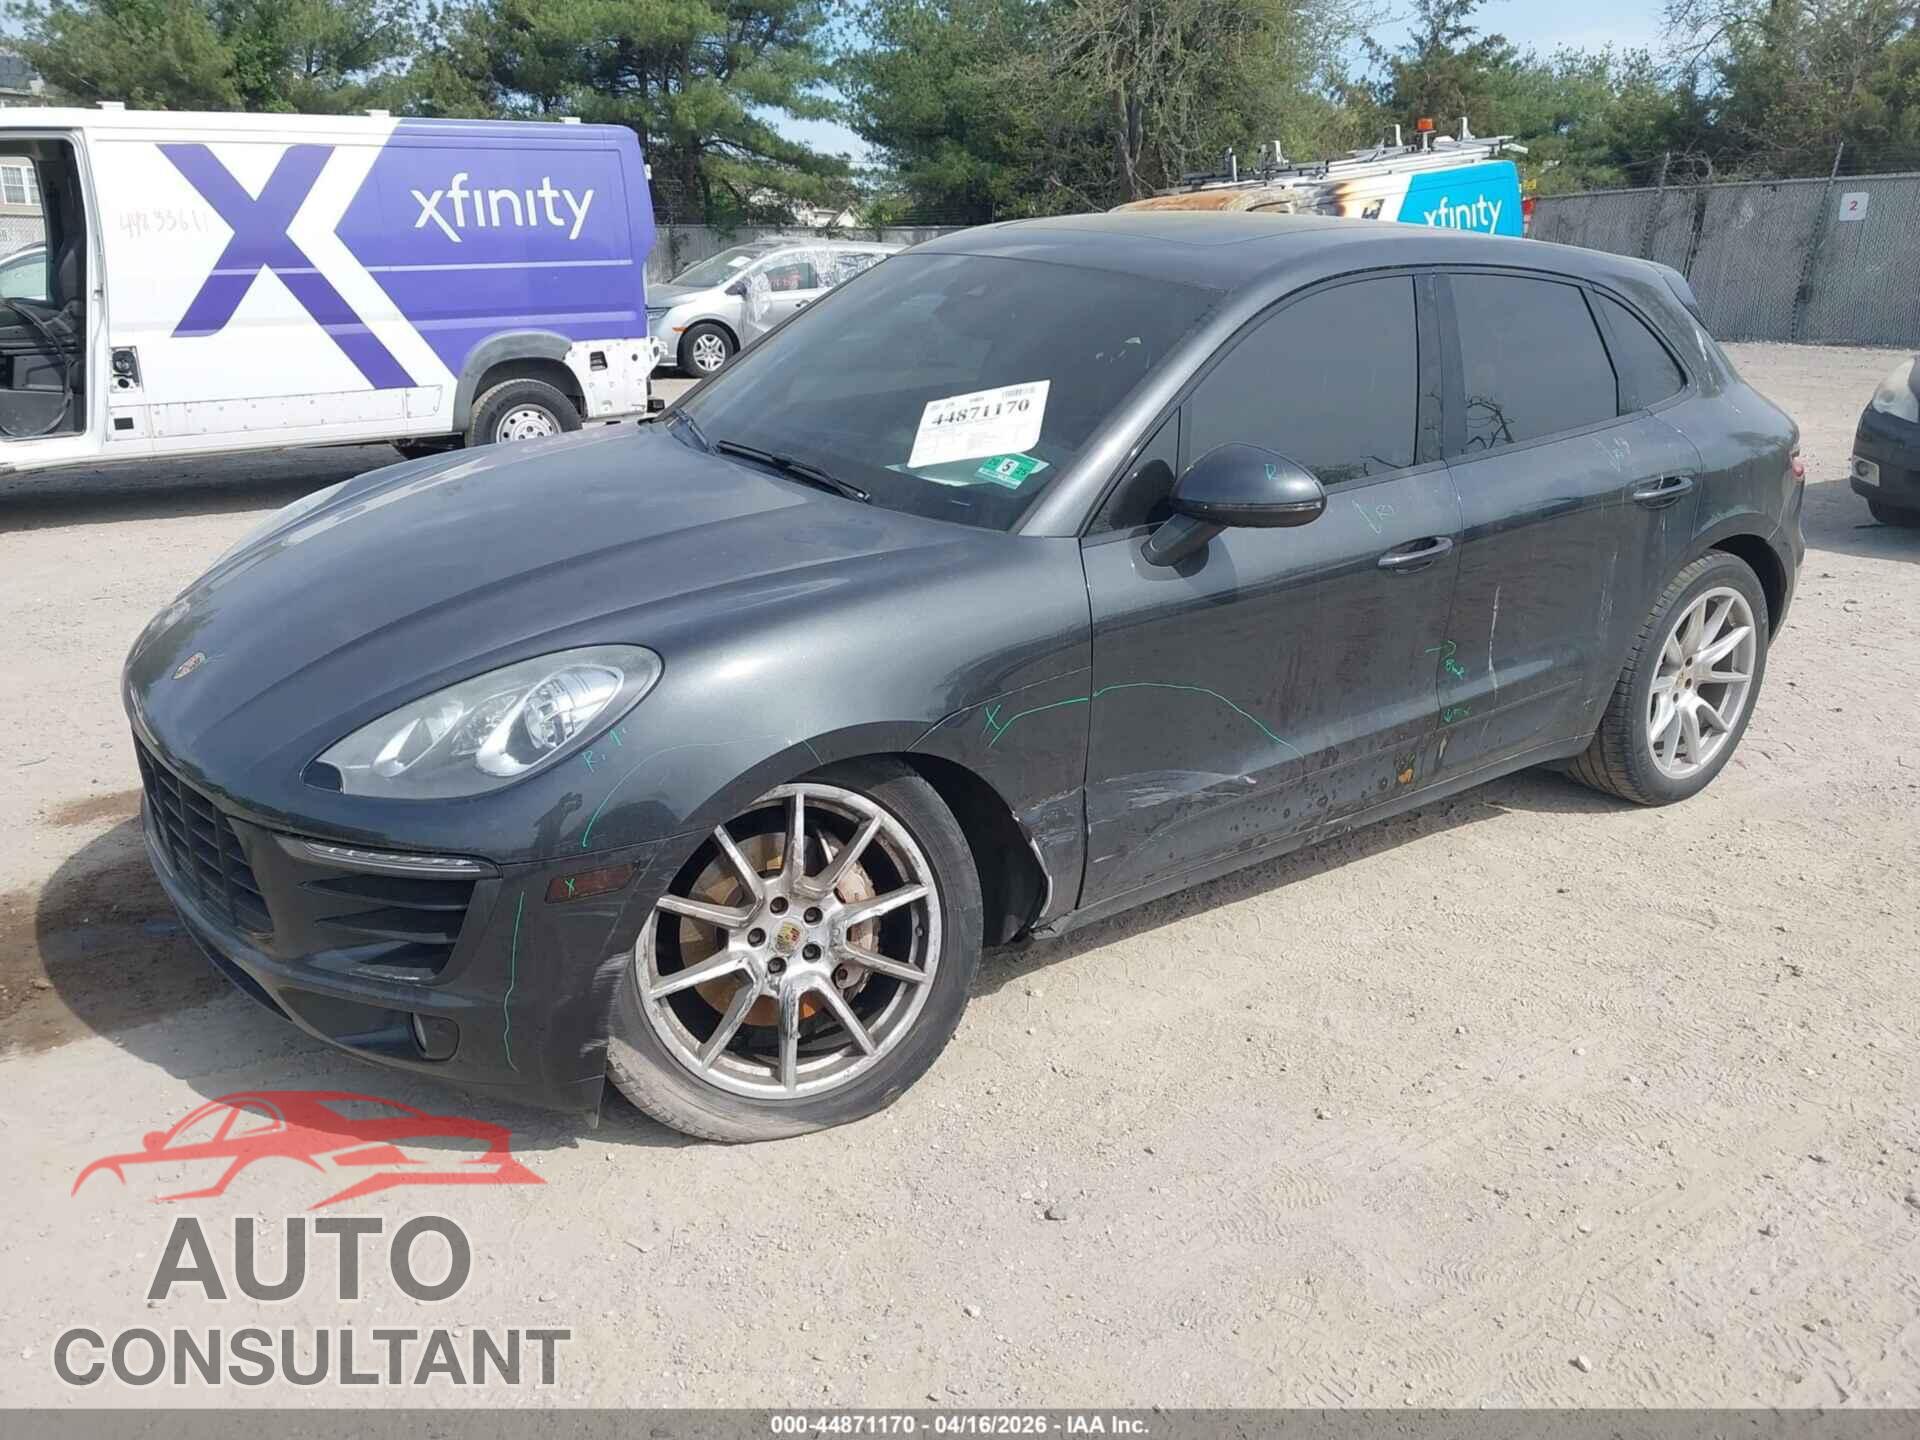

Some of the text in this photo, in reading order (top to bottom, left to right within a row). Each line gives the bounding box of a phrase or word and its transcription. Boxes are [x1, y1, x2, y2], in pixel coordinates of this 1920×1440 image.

[410, 172, 595, 243] xfinity
[1424, 193, 1503, 234] xfinity
[1849, 200, 1858, 211] 2
[931, 398, 1030, 425] 44871170
[1002, 461, 1014, 472] 5
